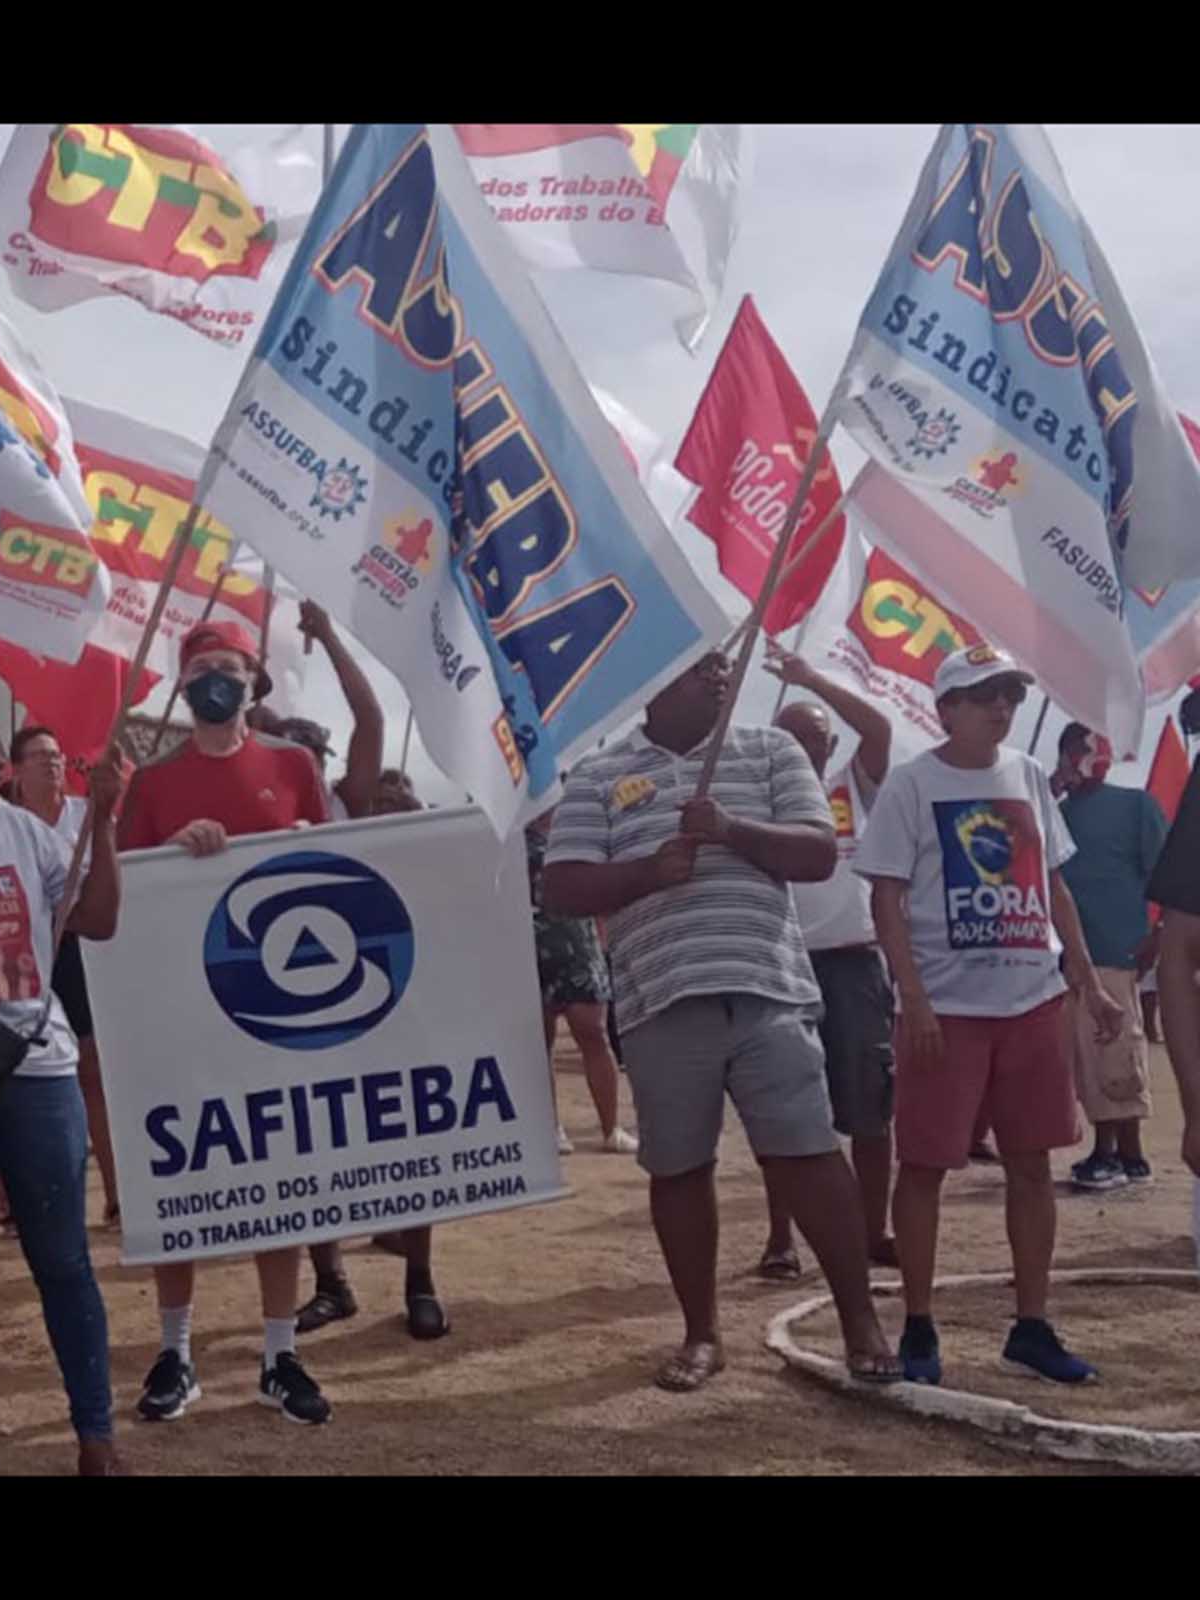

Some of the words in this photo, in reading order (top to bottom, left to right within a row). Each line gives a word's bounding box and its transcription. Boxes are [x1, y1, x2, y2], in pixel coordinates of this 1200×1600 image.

[46, 125, 264, 270] CTB
[479, 177, 529, 198] dos
[539, 174, 649, 199] Trabalh
[492, 203, 588, 223] adoras
[598, 203, 635, 222] do
[241, 401, 328, 482] ASSUFBA
[280, 316, 455, 500] Sindic
[85, 471, 257, 595] CTB
[1041, 526, 1121, 606] FASUBR
[861, 579, 966, 659] CT
[948, 885, 1046, 919] FORA
[144, 1056, 517, 1178] SAFITEBA
[157, 1184, 266, 1219] SINDICATO
[277, 1175, 319, 1201] DOS
[330, 1155, 441, 1192] AUDITORES
[452, 1141, 523, 1174] FISCAIS
[162, 1230, 193, 1252] DO
[200, 1211, 306, 1247] TRABALHO
[312, 1205, 343, 1227] DO
[349, 1191, 426, 1223] ESTADO
[432, 1187, 461, 1208] DA
[464, 1175, 527, 1202] BAHIA
